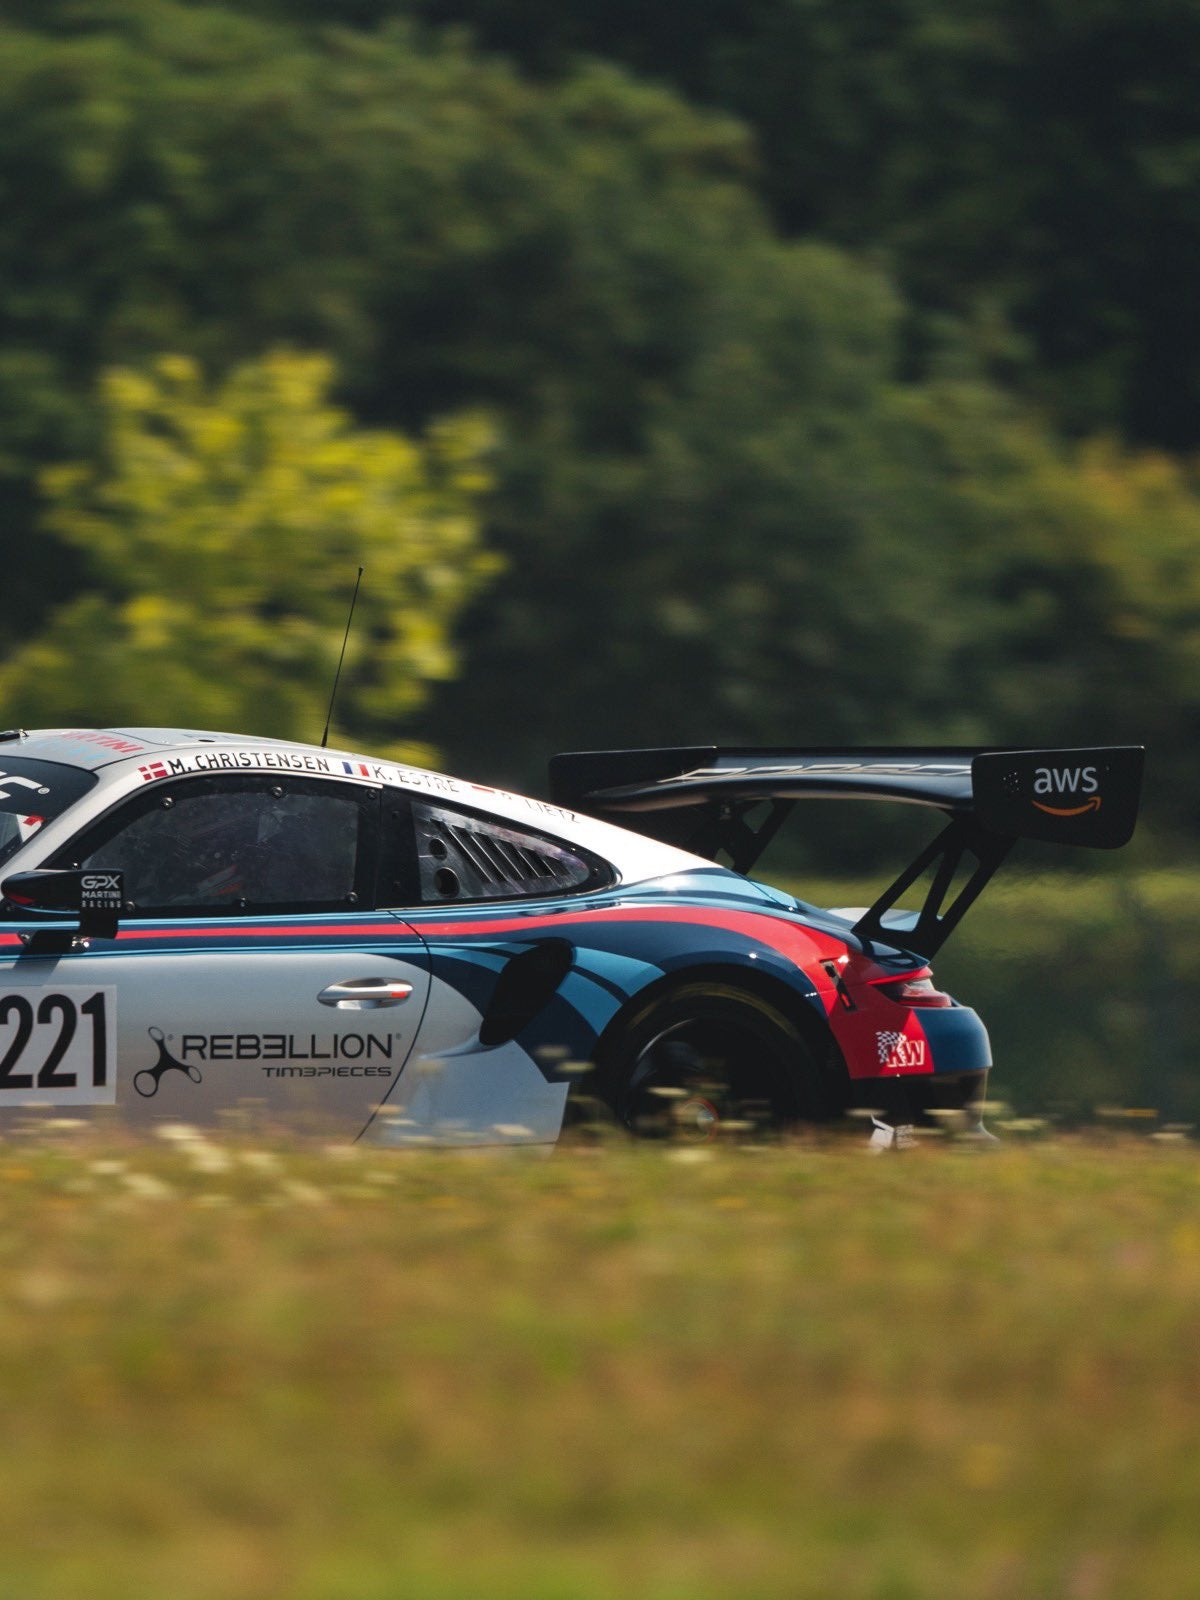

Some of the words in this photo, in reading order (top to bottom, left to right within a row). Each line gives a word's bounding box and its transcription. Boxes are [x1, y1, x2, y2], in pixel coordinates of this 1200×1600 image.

[167, 758, 192, 775] M.
[195, 752, 330, 772] CHRISTENSEN
[371, 766, 393, 782] K.
[398, 770, 460, 793] ESTRE
[1033, 766, 1099, 794] aws
[81, 875, 121, 889] GPX
[81, 890, 121, 899] MARTINI
[81, 900, 121, 908] RACING
